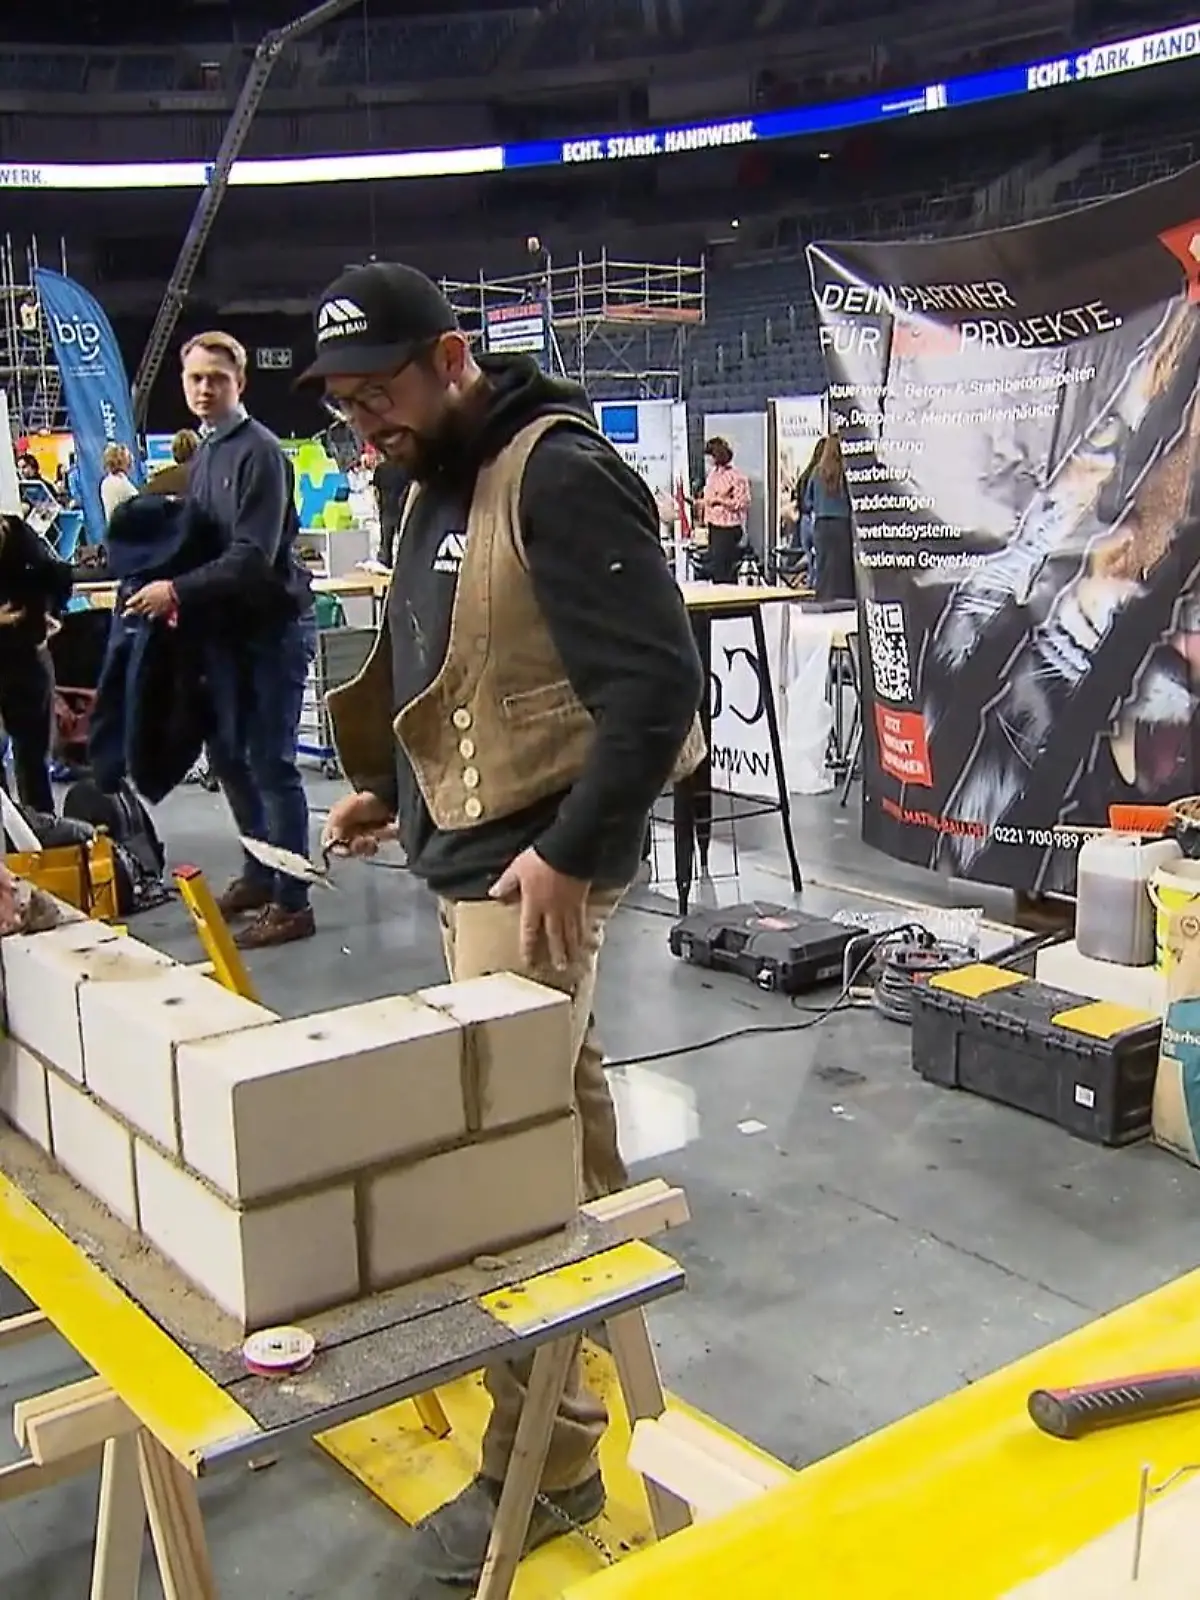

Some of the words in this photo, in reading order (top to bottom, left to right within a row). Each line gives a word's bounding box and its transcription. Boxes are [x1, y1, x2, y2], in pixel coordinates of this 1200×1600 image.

[1027, 62, 1072, 90] ECHT.
[1075, 48, 1135, 79] STARK.
[1142, 26, 1200, 64] HAND
[562, 141, 604, 162] ECHT.
[606, 134, 662, 159] STARK.
[664, 120, 757, 152] HANDWERK.
[821, 283, 896, 315] DEIN
[899, 280, 1017, 314] PARTNER
[818, 318, 882, 357] FÜR
[957, 299, 1123, 353] PROJEKTE.
[994, 827, 1023, 844] 0221
